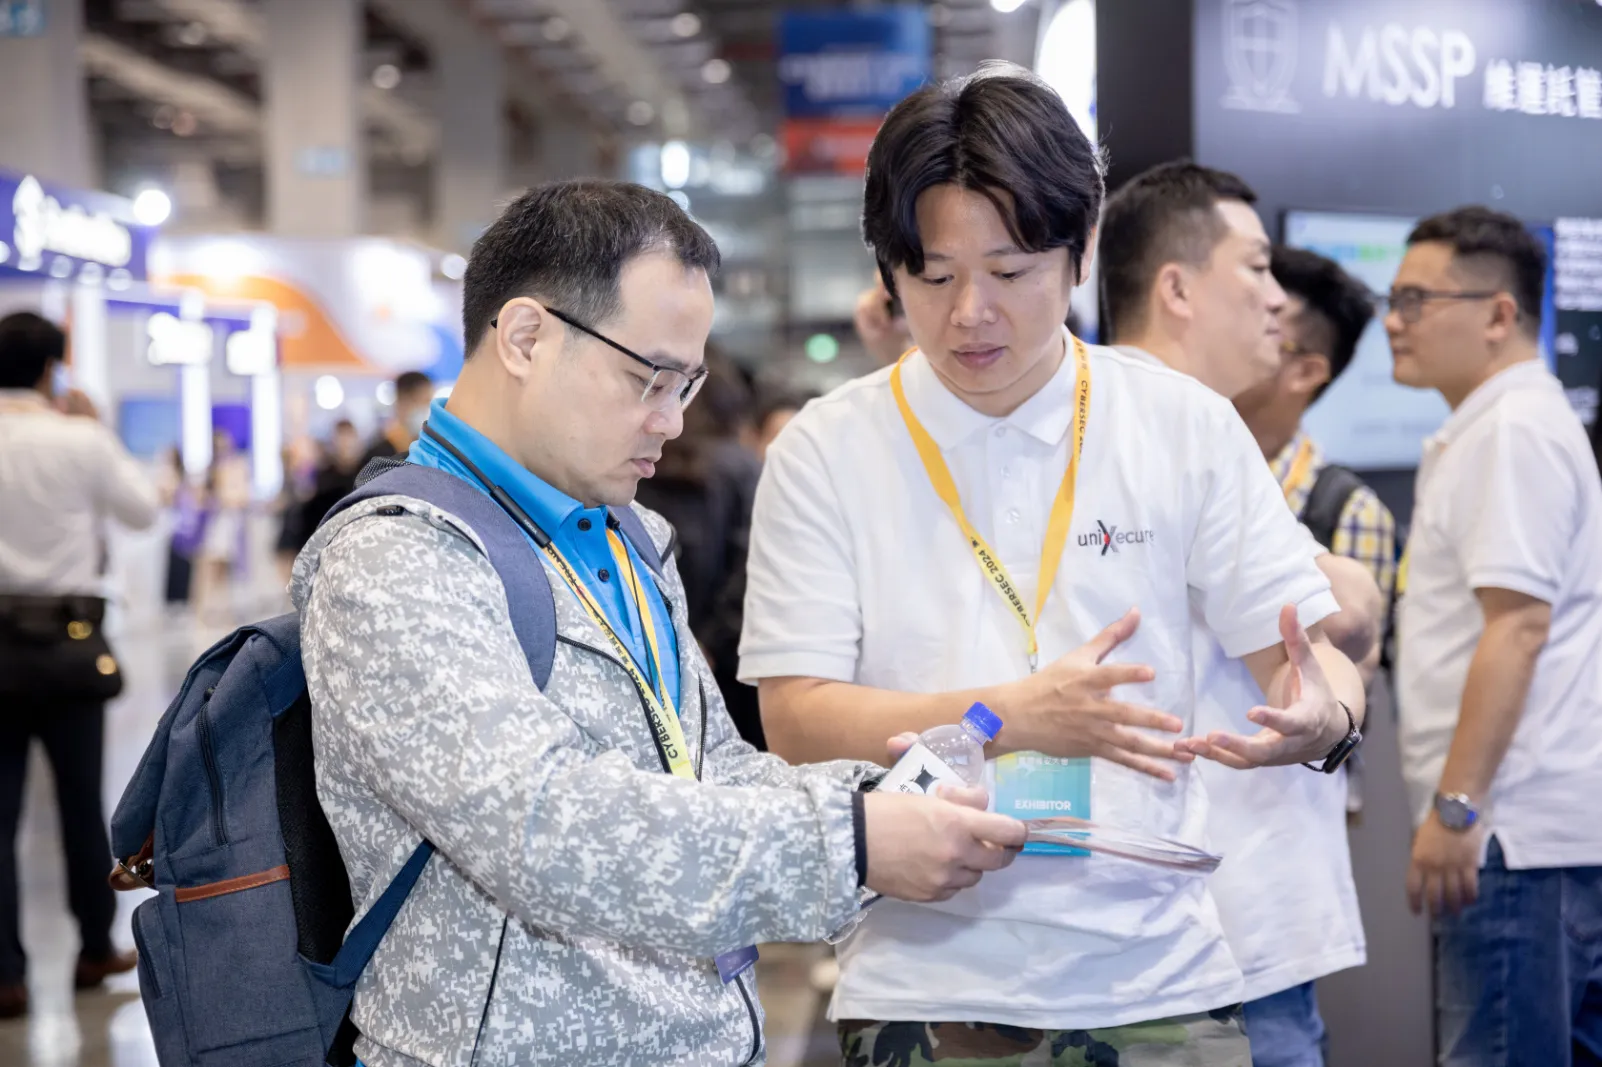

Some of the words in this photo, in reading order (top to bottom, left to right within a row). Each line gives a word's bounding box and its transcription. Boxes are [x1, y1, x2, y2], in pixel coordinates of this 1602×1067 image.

[1322, 22, 1476, 109] MSSP
[1079, 379, 1088, 433] CYBERSEC
[978, 549, 999, 575] 2024
[1014, 799, 1072, 811] EXHIBITOR
